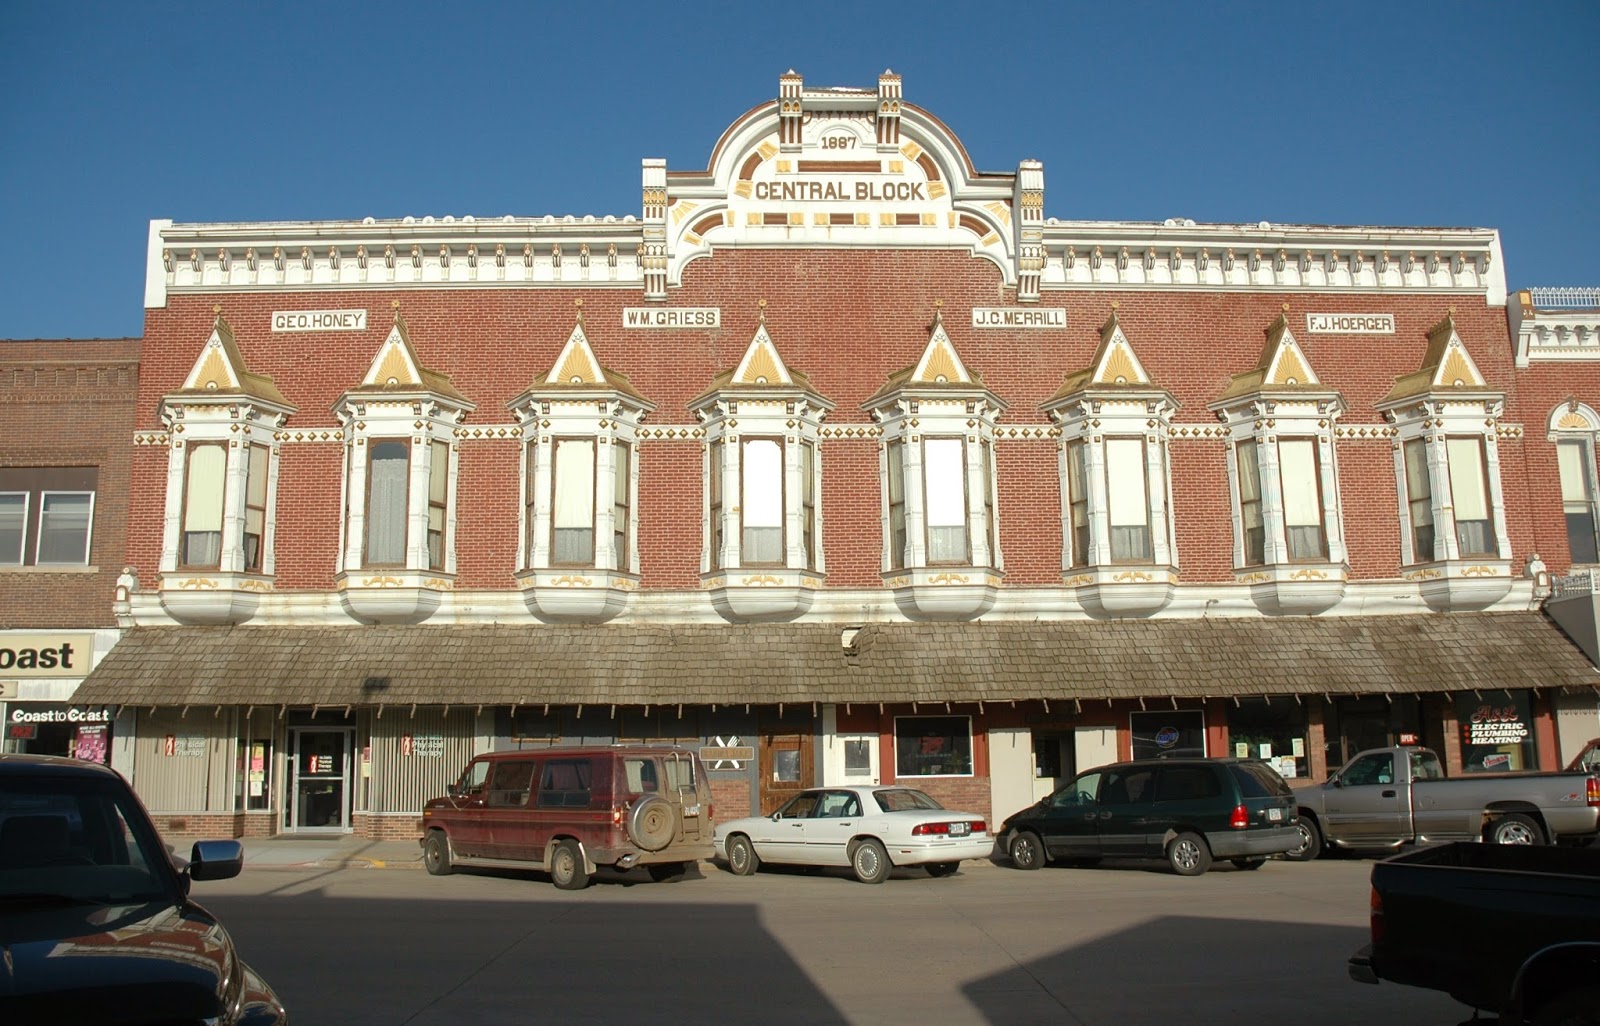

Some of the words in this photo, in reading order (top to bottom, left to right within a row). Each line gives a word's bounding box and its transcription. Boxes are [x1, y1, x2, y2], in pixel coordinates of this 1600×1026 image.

[821, 136, 857, 150] 1887
[755, 181, 851, 200] CENTRAL
[855, 181, 926, 201] BLOCK
[0, 643, 74, 670] oast
[12, 709, 54, 722] Coast
[55, 710, 66, 722] to
[1470, 722, 1524, 732] ELECTRIC
[1471, 729, 1528, 738] PLUMBING
[1471, 736, 1522, 745] HEATING
